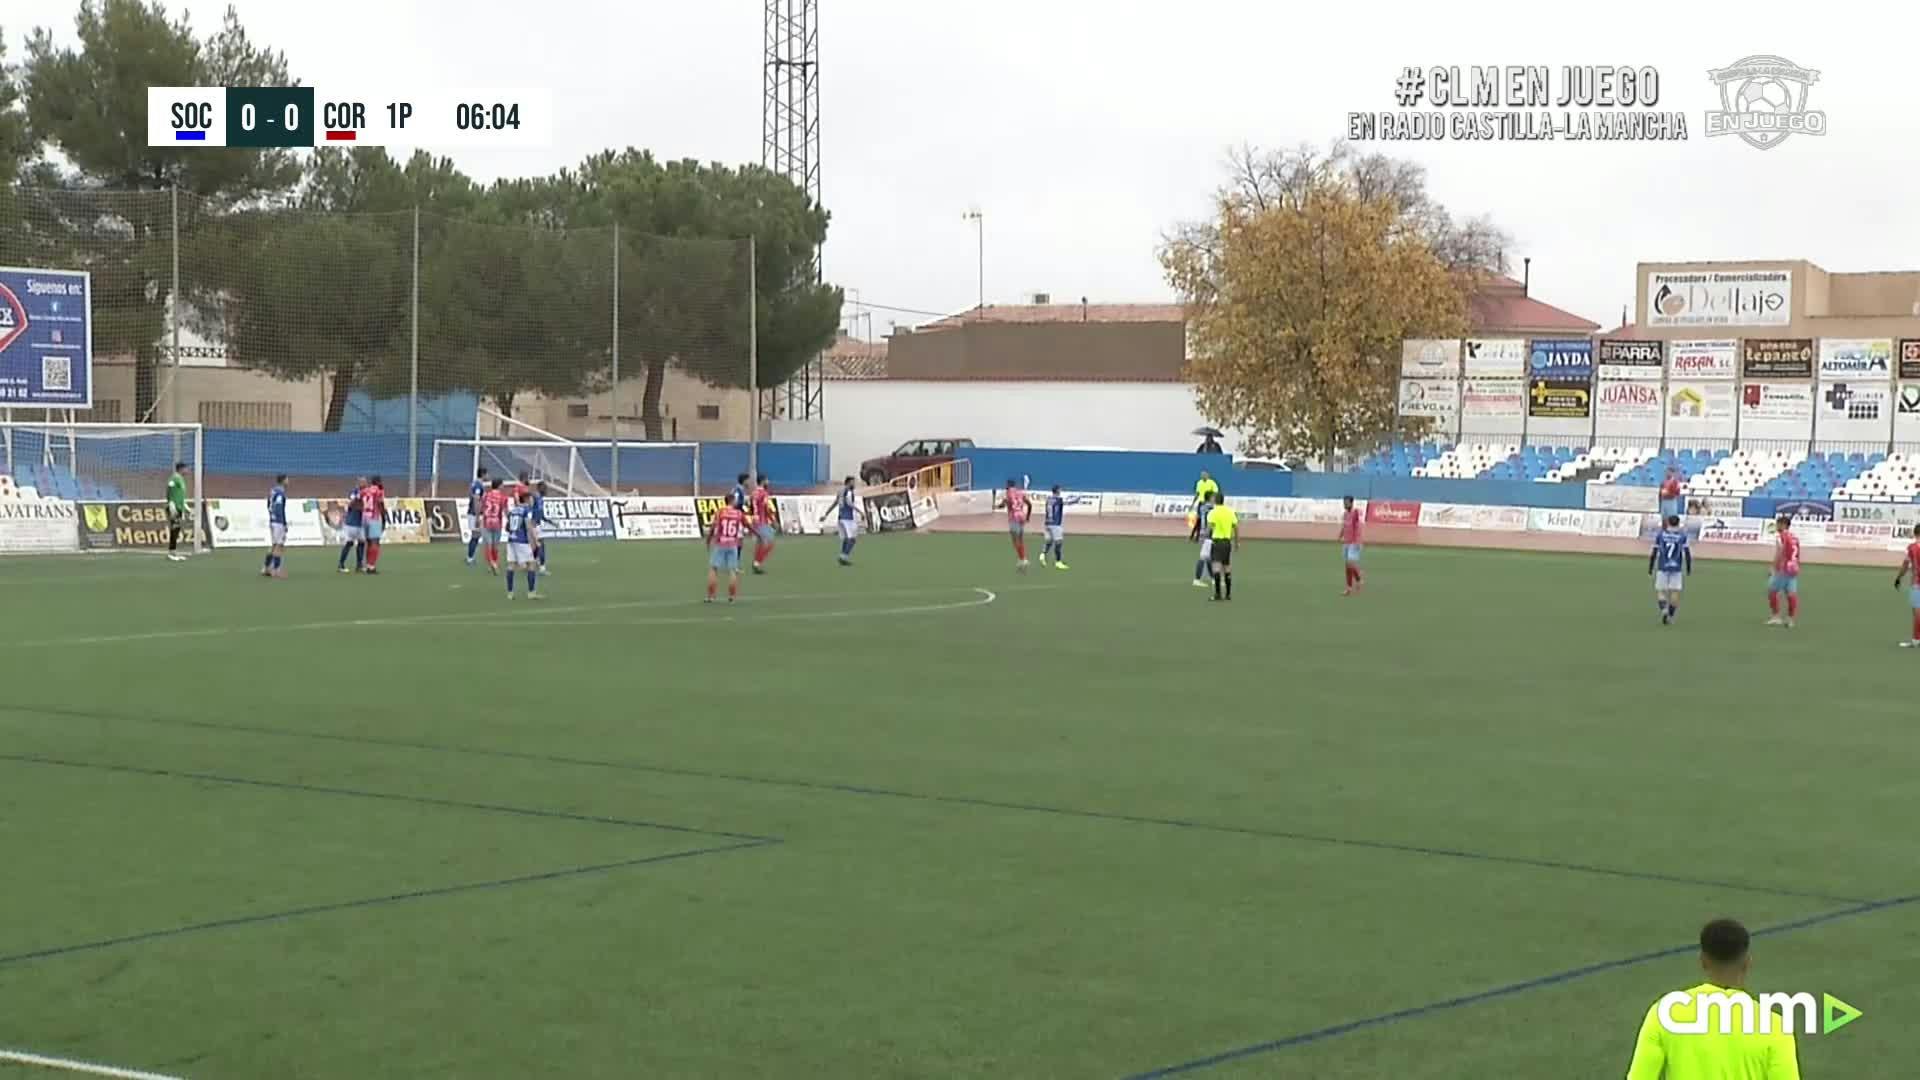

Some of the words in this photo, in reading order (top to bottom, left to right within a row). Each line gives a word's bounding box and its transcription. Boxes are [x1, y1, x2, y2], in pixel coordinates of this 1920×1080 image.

[1656, 275, 1706, 283] Procesadora
[1546, 352, 1591, 367] JAYDA
[0, 503, 73, 518] VATRANS
[116, 505, 167, 523] Casa
[721, 520, 737, 536] 16
[1666, 543, 1675, 559] 7
